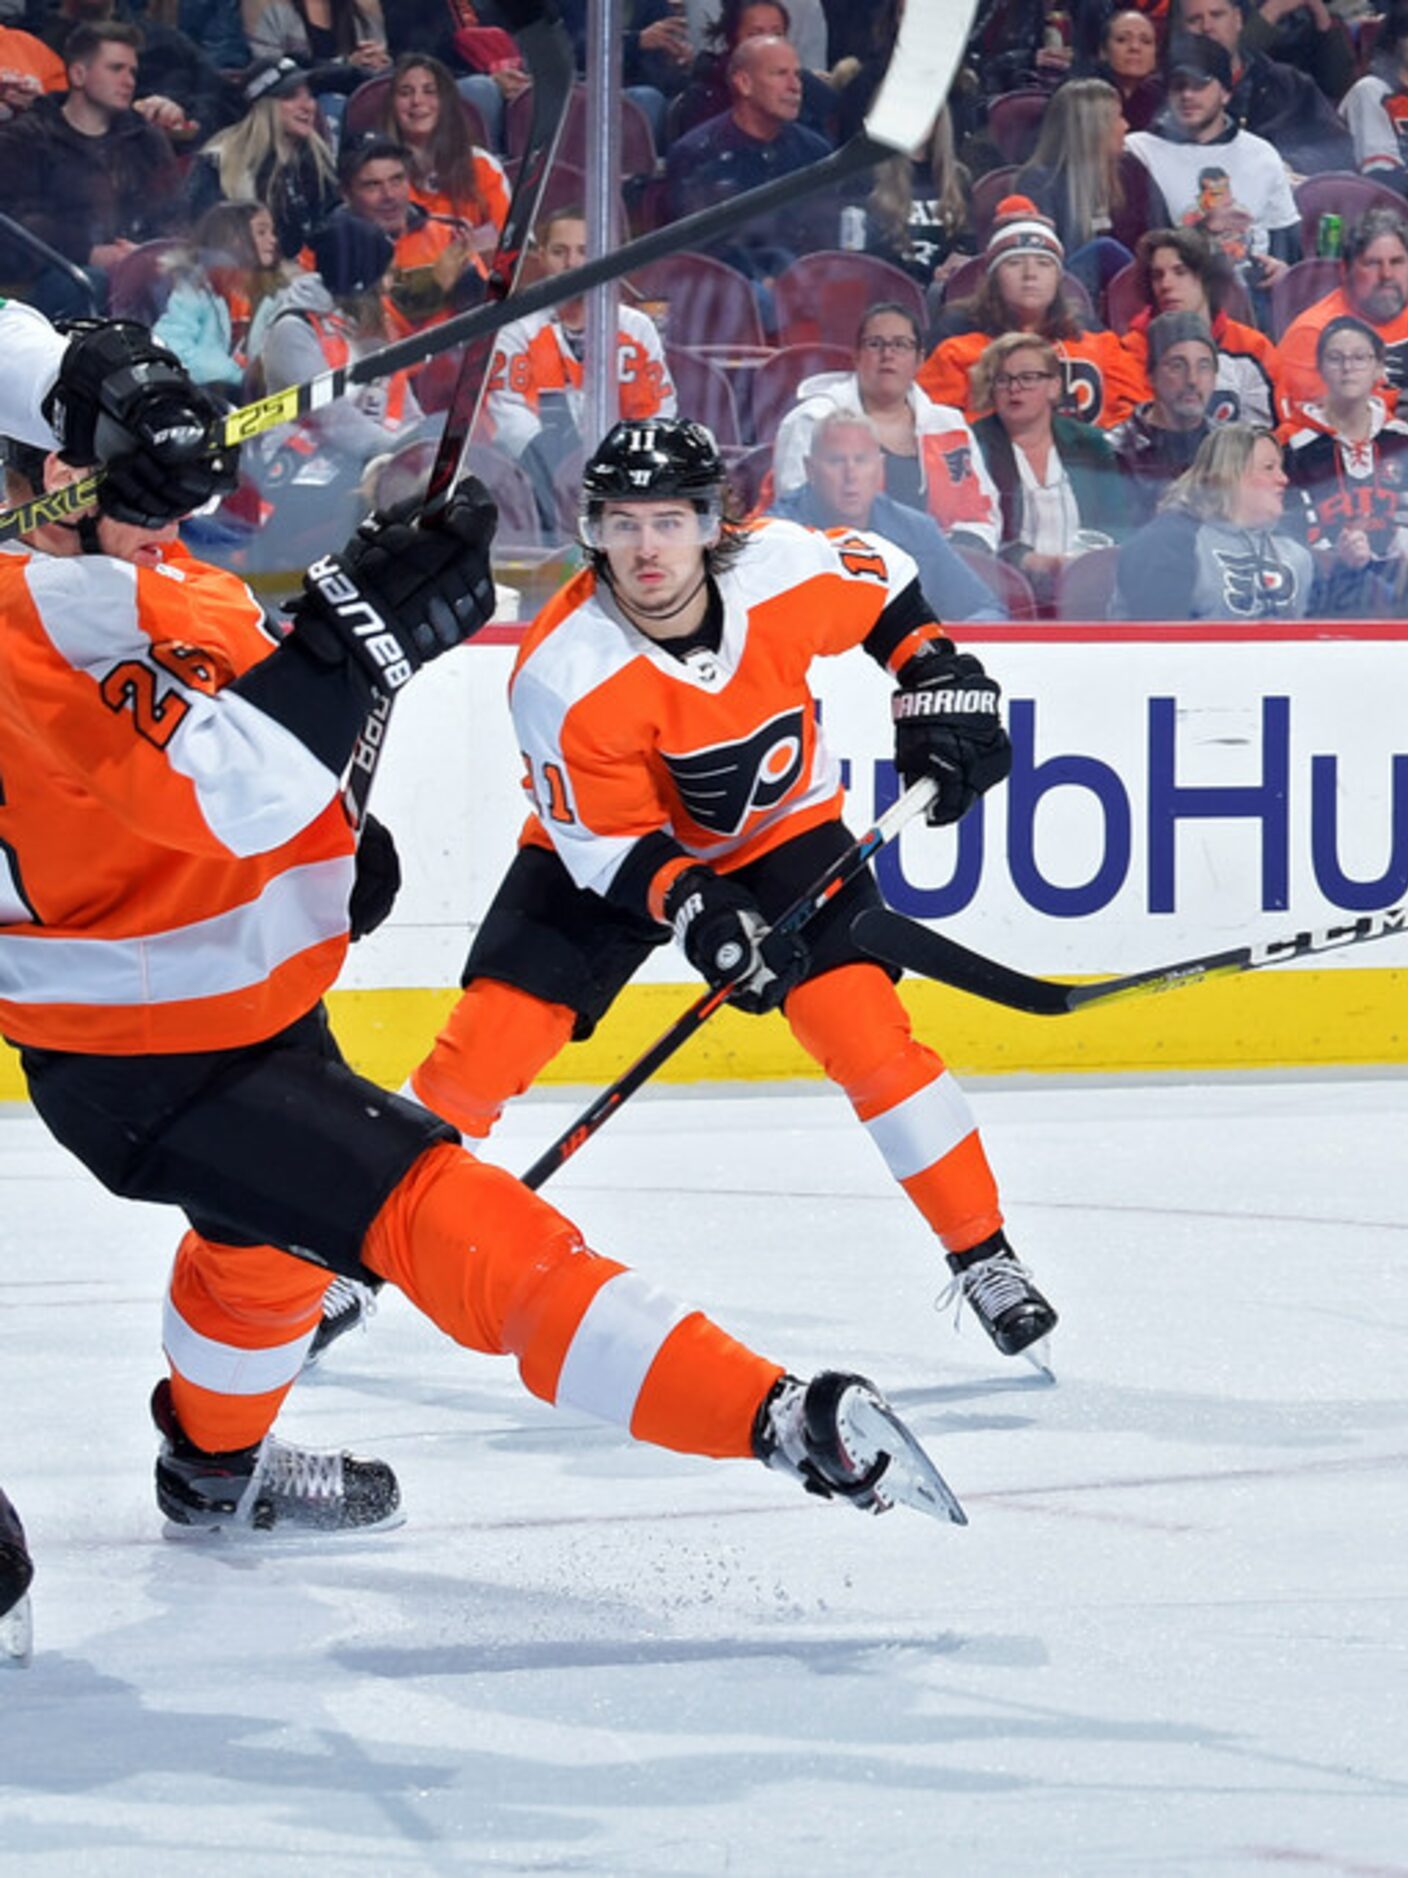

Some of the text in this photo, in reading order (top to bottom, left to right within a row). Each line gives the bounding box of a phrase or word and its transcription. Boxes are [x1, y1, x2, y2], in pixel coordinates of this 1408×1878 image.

[238, 397, 286, 437] 25
[629, 430, 656, 451] 11
[307, 554, 413, 689] BAUER
[99, 640, 238, 751] 26
[893, 688, 998, 718] ARRIOR
[353, 686, 392, 775] BAU
